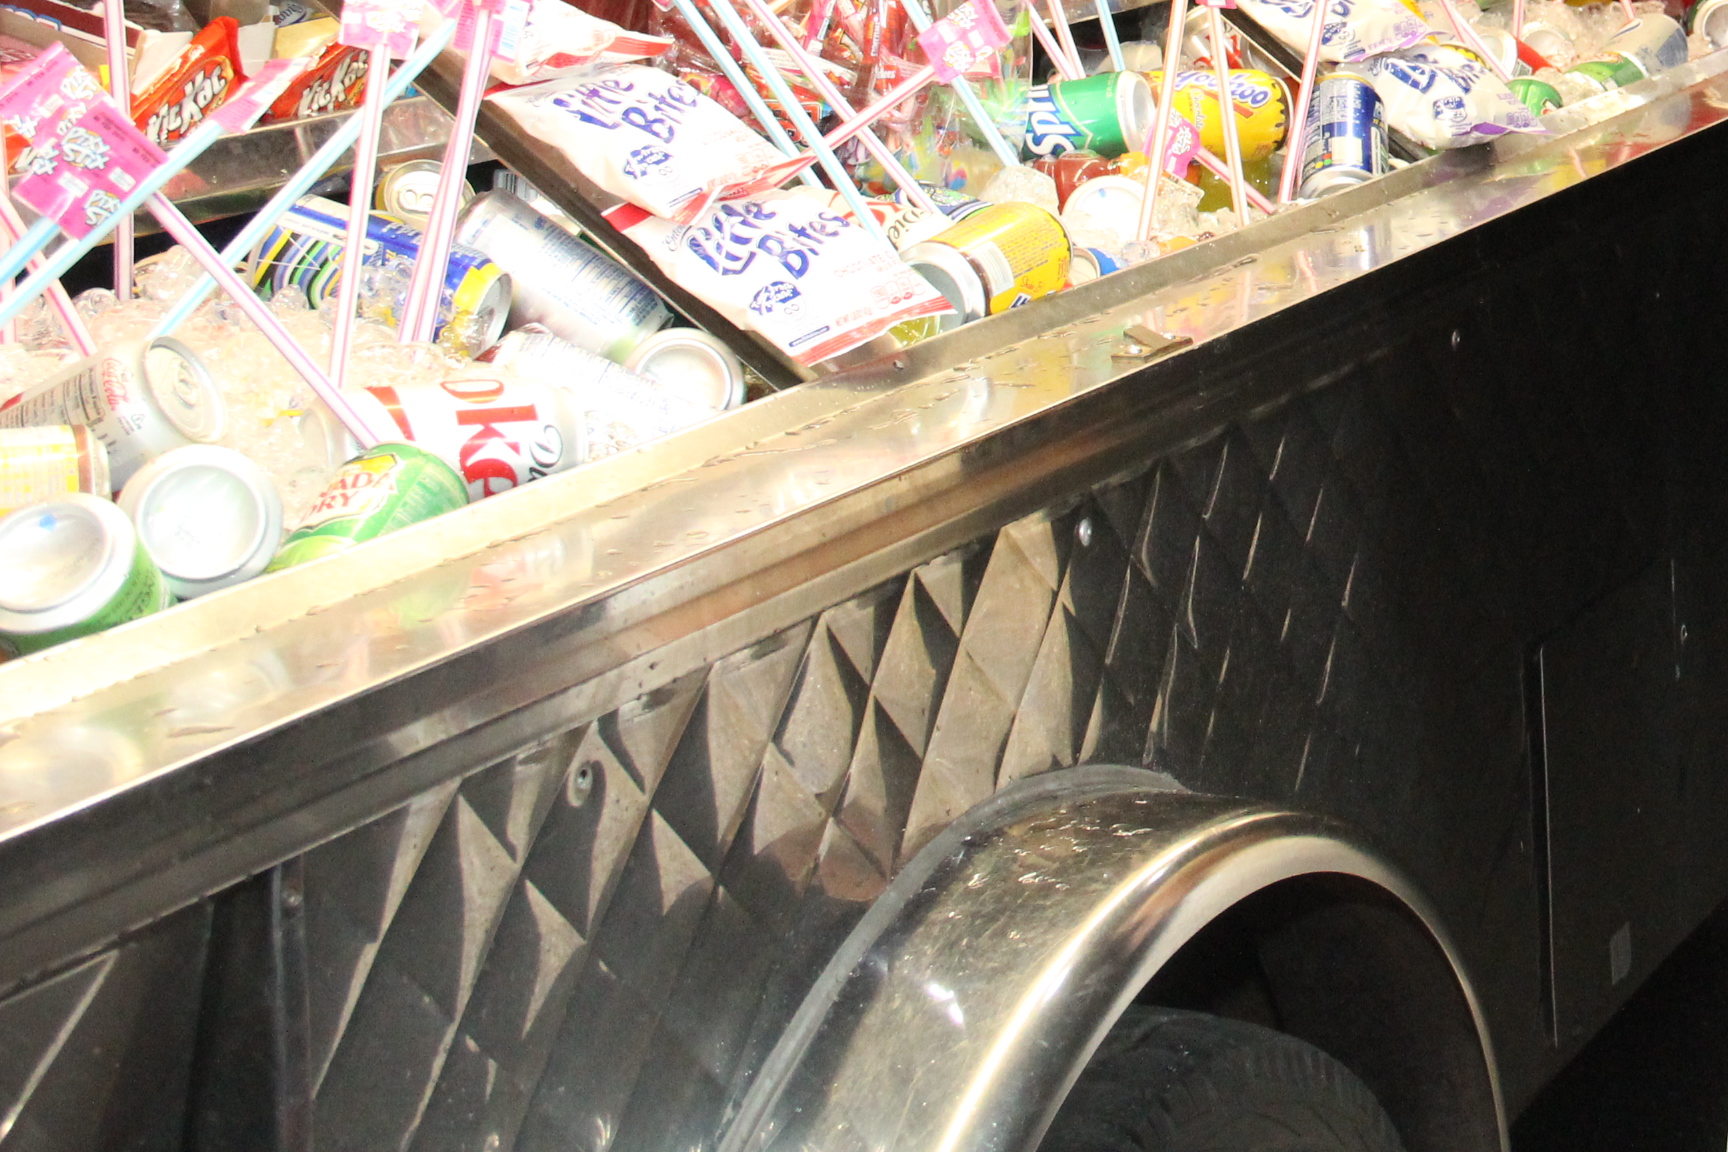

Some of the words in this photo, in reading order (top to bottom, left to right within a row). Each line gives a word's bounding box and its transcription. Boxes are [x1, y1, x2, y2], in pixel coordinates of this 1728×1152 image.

[1025, 83, 1078, 156] Spri
[756, 211, 851, 280] Bites
[886, 208, 933, 247] Die
